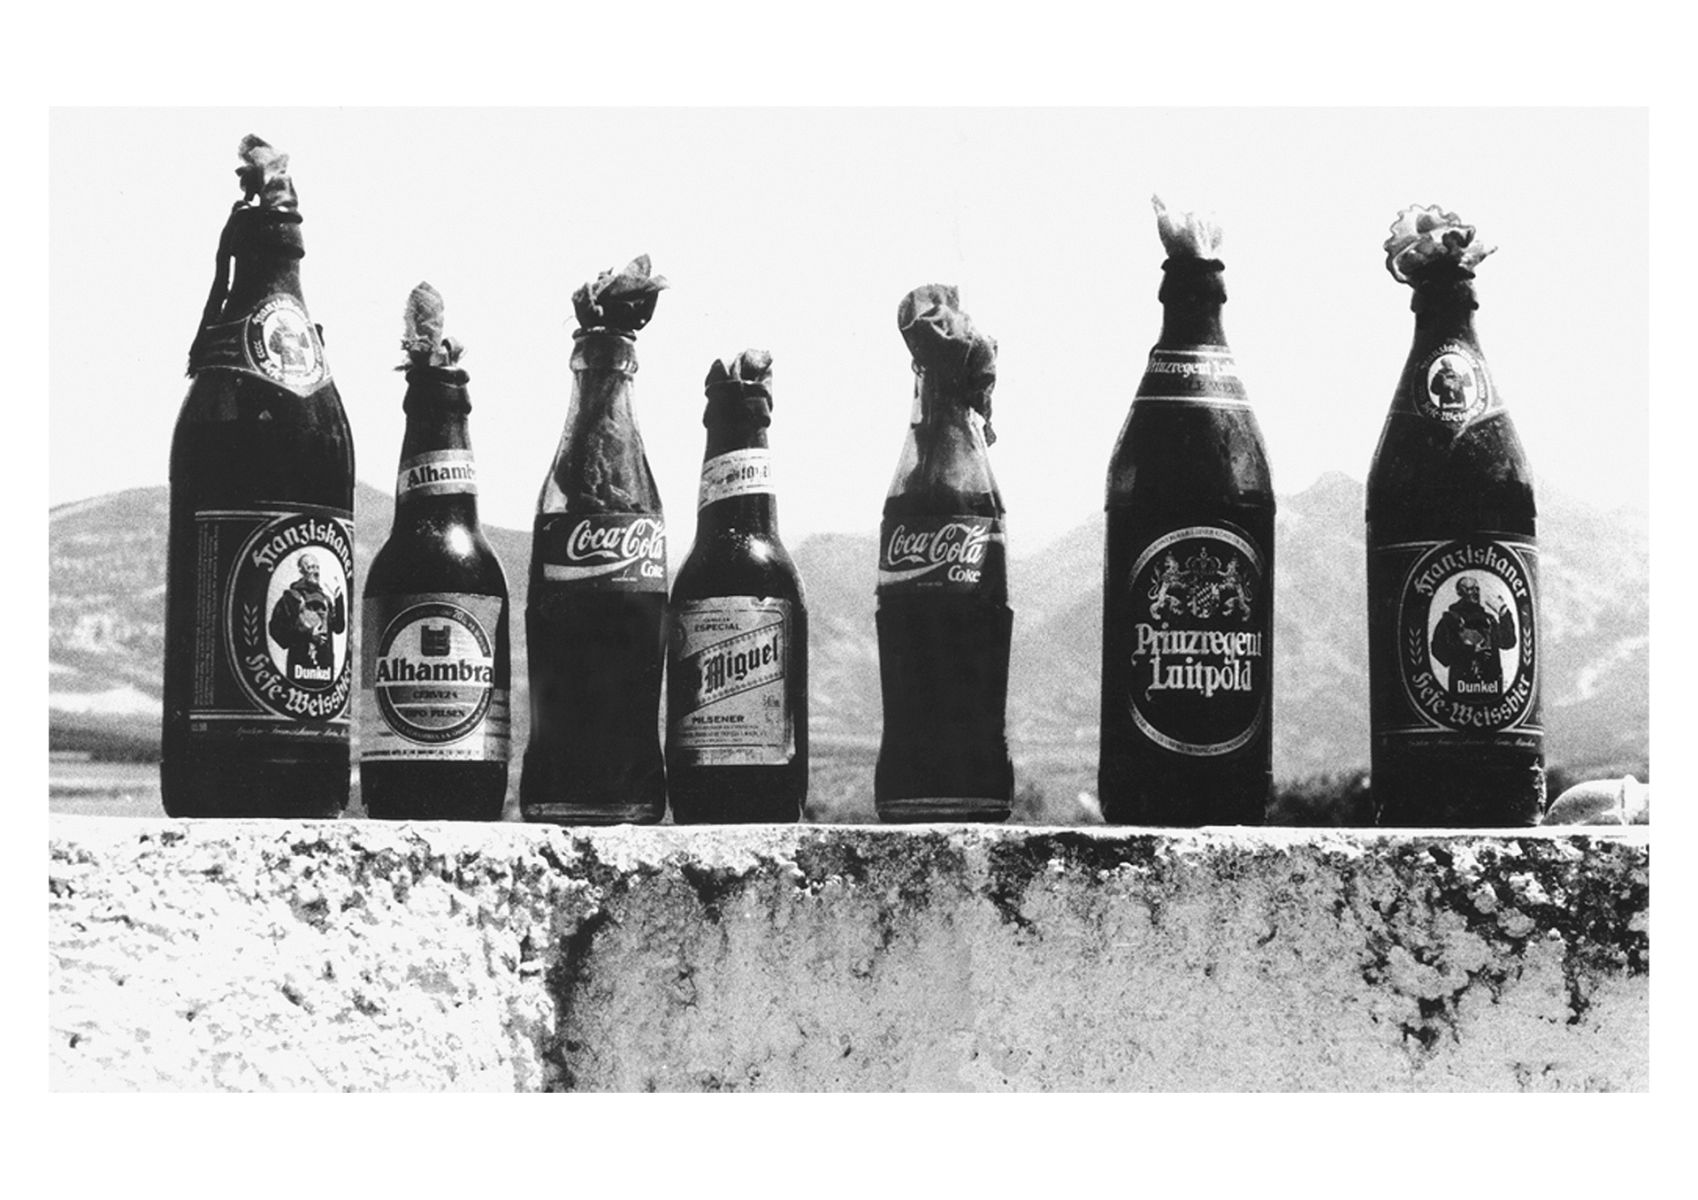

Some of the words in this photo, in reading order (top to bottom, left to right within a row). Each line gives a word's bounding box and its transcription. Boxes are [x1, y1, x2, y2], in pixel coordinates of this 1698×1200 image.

[567, 518, 666, 560] Coca-Cola
[888, 523, 984, 565] Coca-Cola
[948, 564, 981, 583] Coke
[1414, 544, 1528, 598] Franziskaner
[703, 634, 779, 694] Miguel
[1132, 622, 1262, 666] Prinzregent
[294, 664, 331, 680] Dunkel
[376, 658, 494, 683] Alhambra
[1145, 656, 1252, 701] Luitpold
[1457, 680, 1498, 694] Dunkel
[1412, 673, 1531, 727] Hefe-Weissbier
